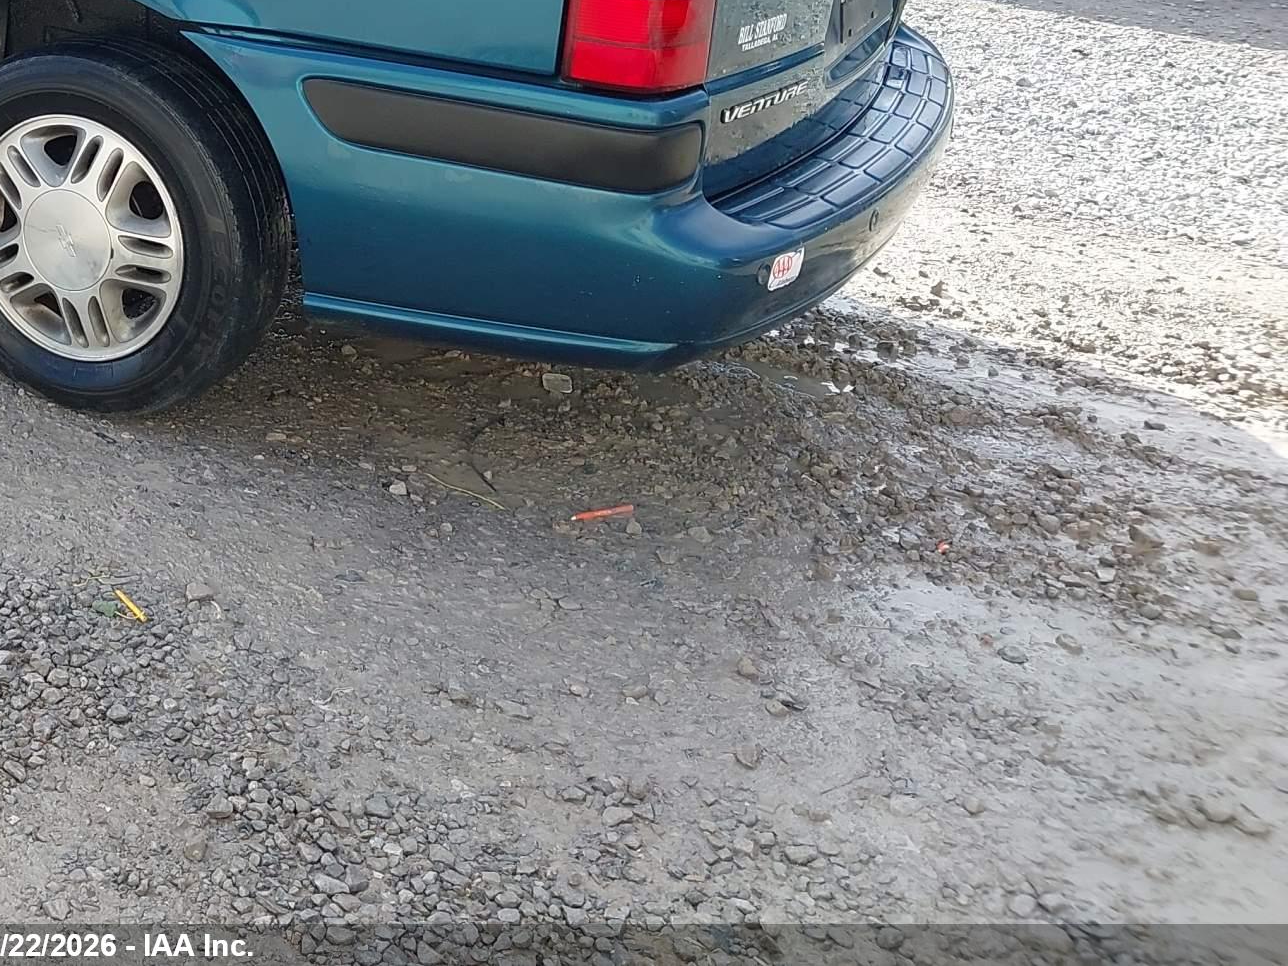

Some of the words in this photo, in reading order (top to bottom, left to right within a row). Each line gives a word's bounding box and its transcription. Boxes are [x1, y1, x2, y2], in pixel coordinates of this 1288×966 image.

[738, 24, 754, 45] BILL
[754, 14, 787, 40] STANFORD
[724, 78, 809, 123] VENTURE
